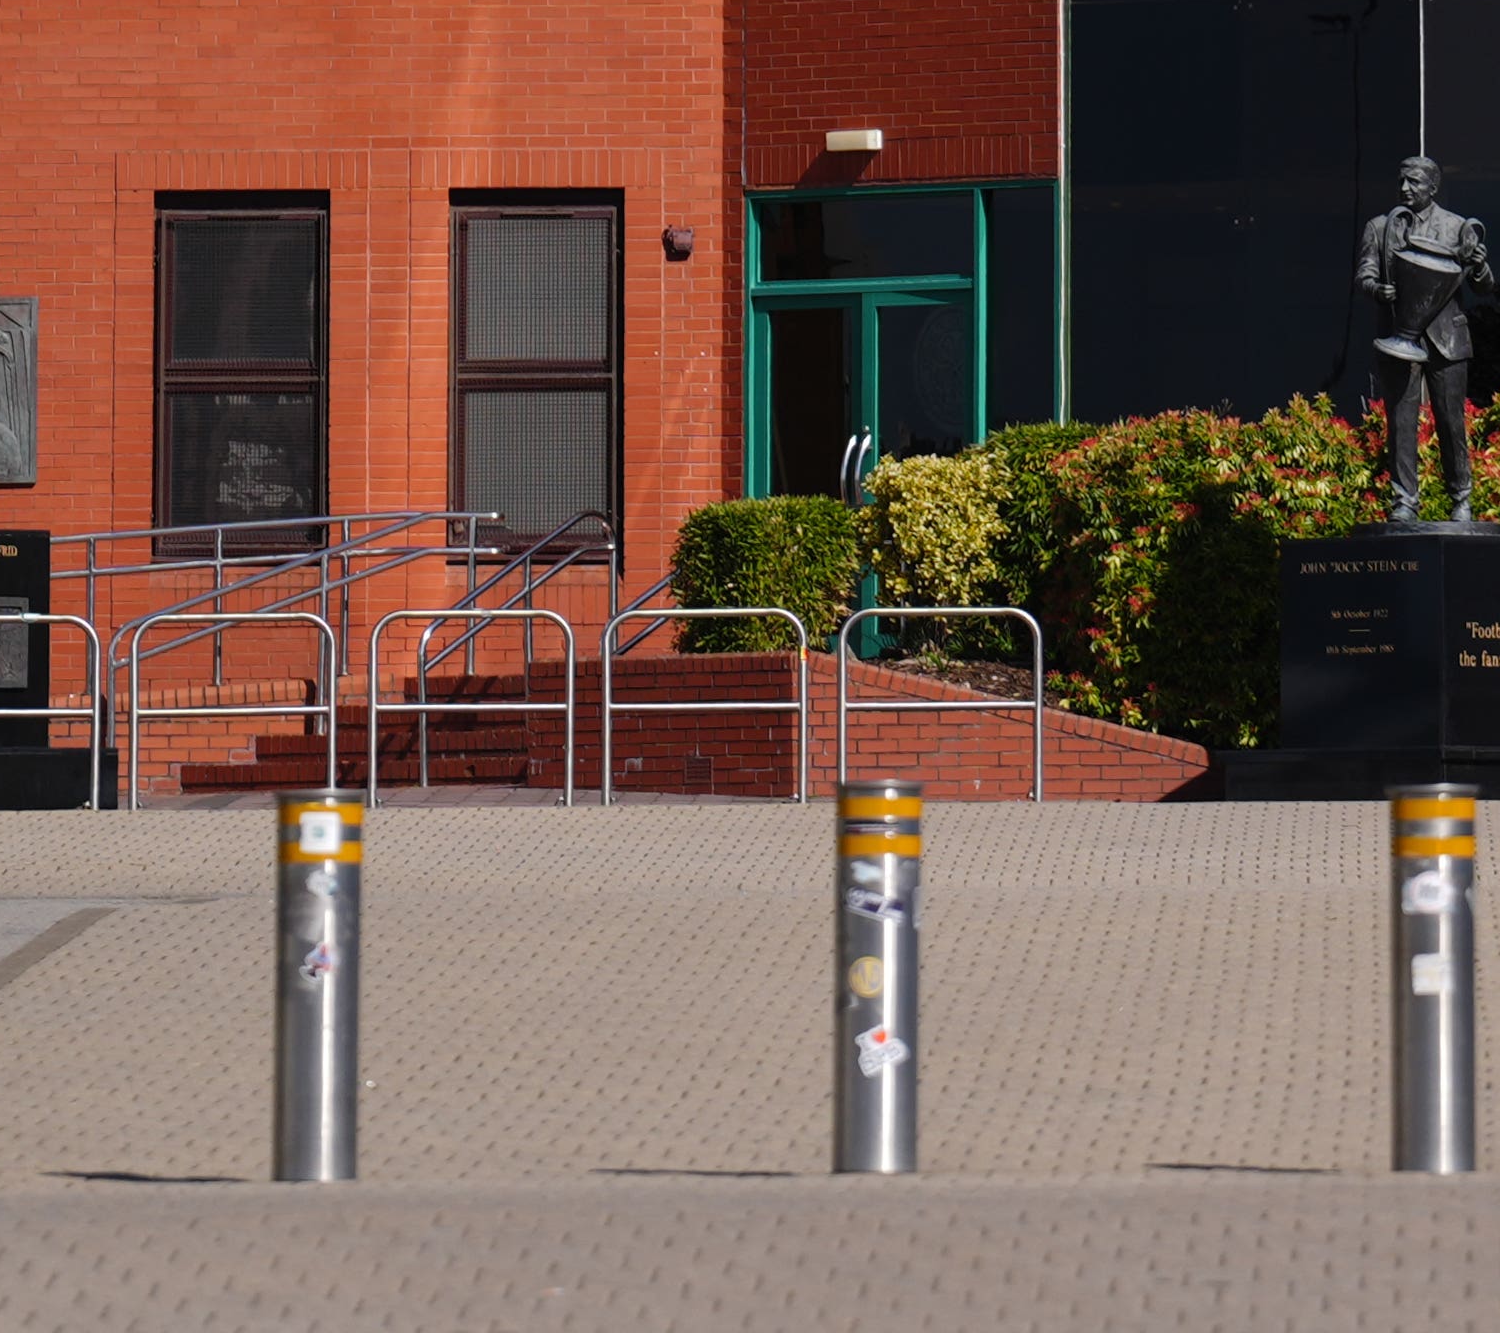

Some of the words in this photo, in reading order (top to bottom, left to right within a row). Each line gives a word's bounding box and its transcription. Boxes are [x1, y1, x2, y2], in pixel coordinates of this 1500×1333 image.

[1299, 562, 1326, 574] JOHN
[1367, 560, 1398, 572] STEIN
[1459, 650, 1477, 667] the
